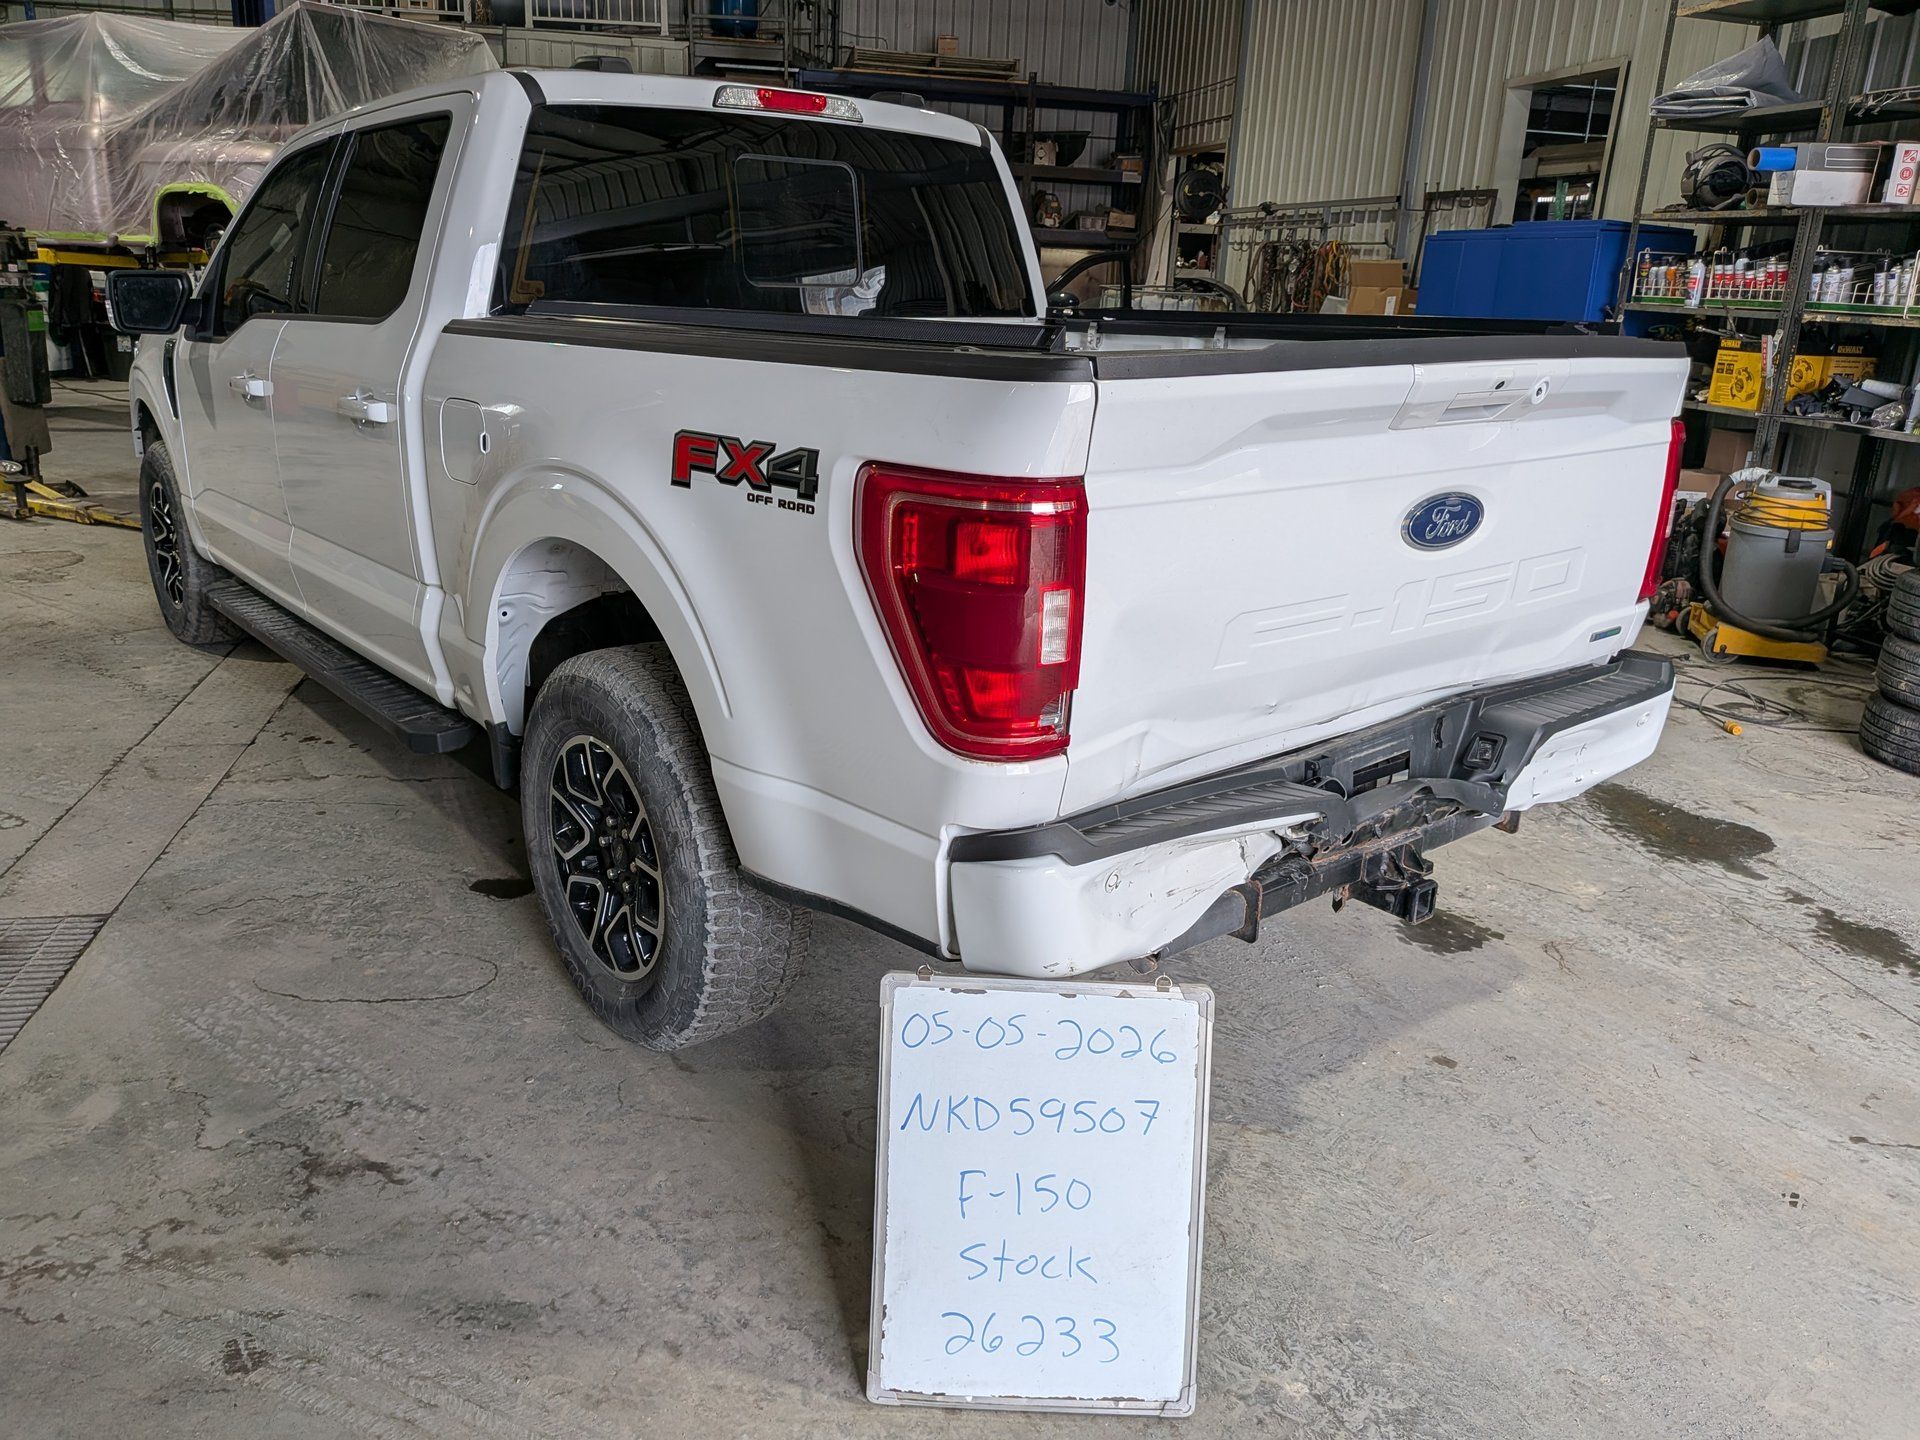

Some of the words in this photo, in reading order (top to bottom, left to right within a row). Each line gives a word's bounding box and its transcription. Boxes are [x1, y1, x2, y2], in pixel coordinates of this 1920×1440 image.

[671, 429, 820, 502] FX4
[746, 492, 774, 506] OFF
[777, 498, 816, 515] ROAD
[1425, 504, 1472, 540] Ford
[1213, 545, 1588, 671] F-150
[901, 1010, 1177, 1064] 05-05-2026
[900, 1093, 1161, 1135] NKD59507
[959, 1169, 1092, 1220] F-150
[941, 1312, 1120, 1364] 26233
